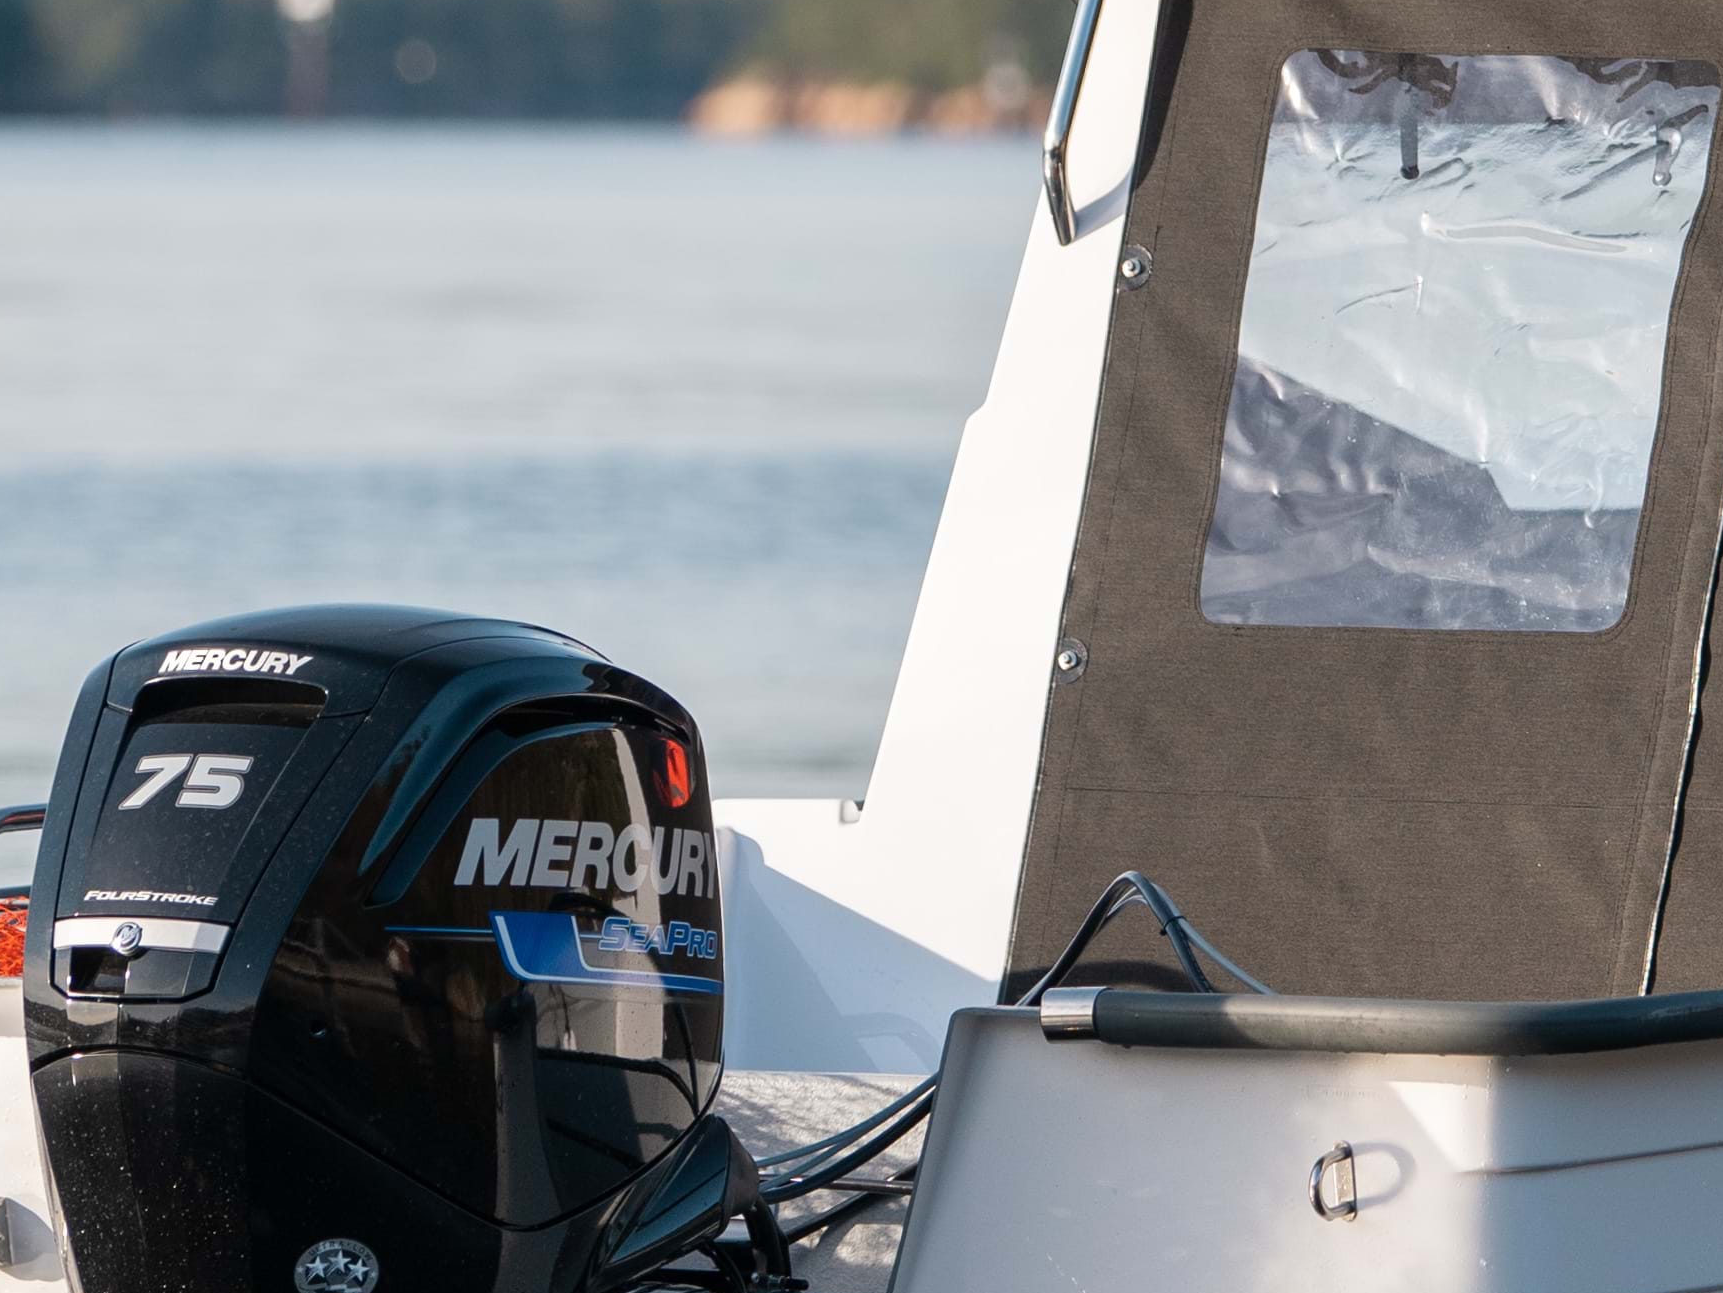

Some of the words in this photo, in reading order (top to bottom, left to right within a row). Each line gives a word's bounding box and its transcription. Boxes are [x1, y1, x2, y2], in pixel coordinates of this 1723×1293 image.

[158, 648, 313, 677] MERCURY
[118, 754, 254, 810] 75
[453, 818, 716, 899] MERCURY
